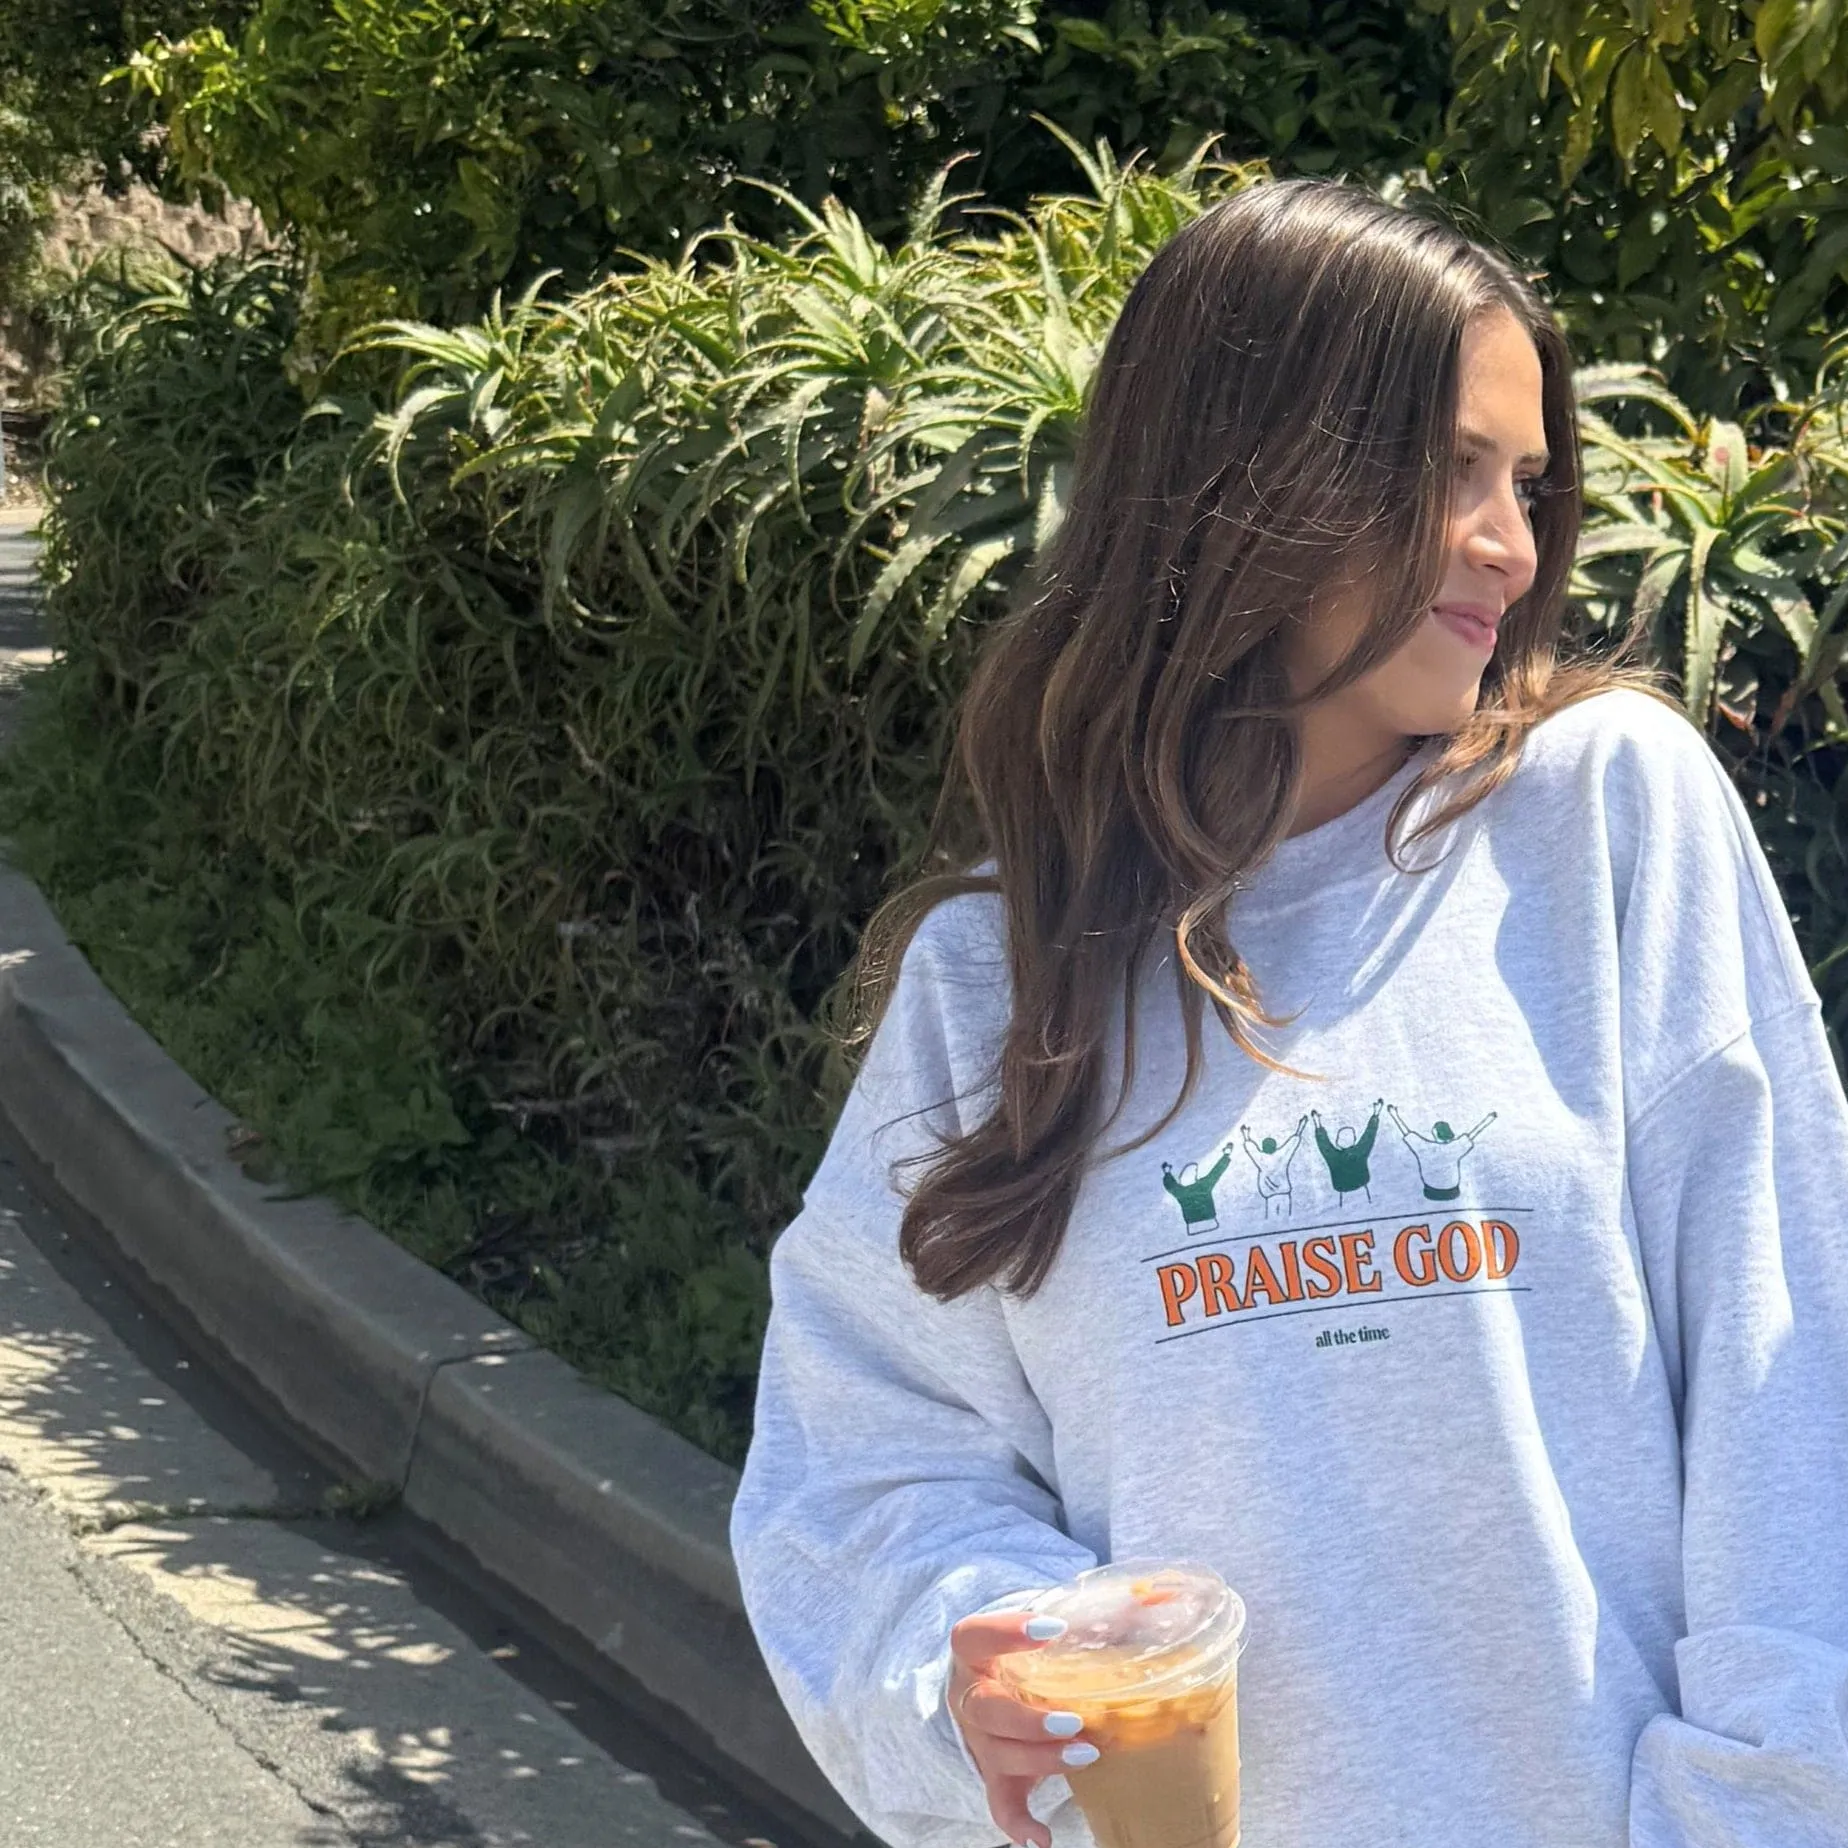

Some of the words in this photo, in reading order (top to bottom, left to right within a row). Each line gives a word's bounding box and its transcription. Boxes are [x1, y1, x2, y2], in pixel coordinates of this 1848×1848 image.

[1157, 1229, 1382, 1327] PRAISE
[1393, 1219, 1520, 1287] GOD
[1315, 1330, 1332, 1348] all
[1333, 1328, 1357, 1345] the
[1358, 1325, 1391, 1343] time
